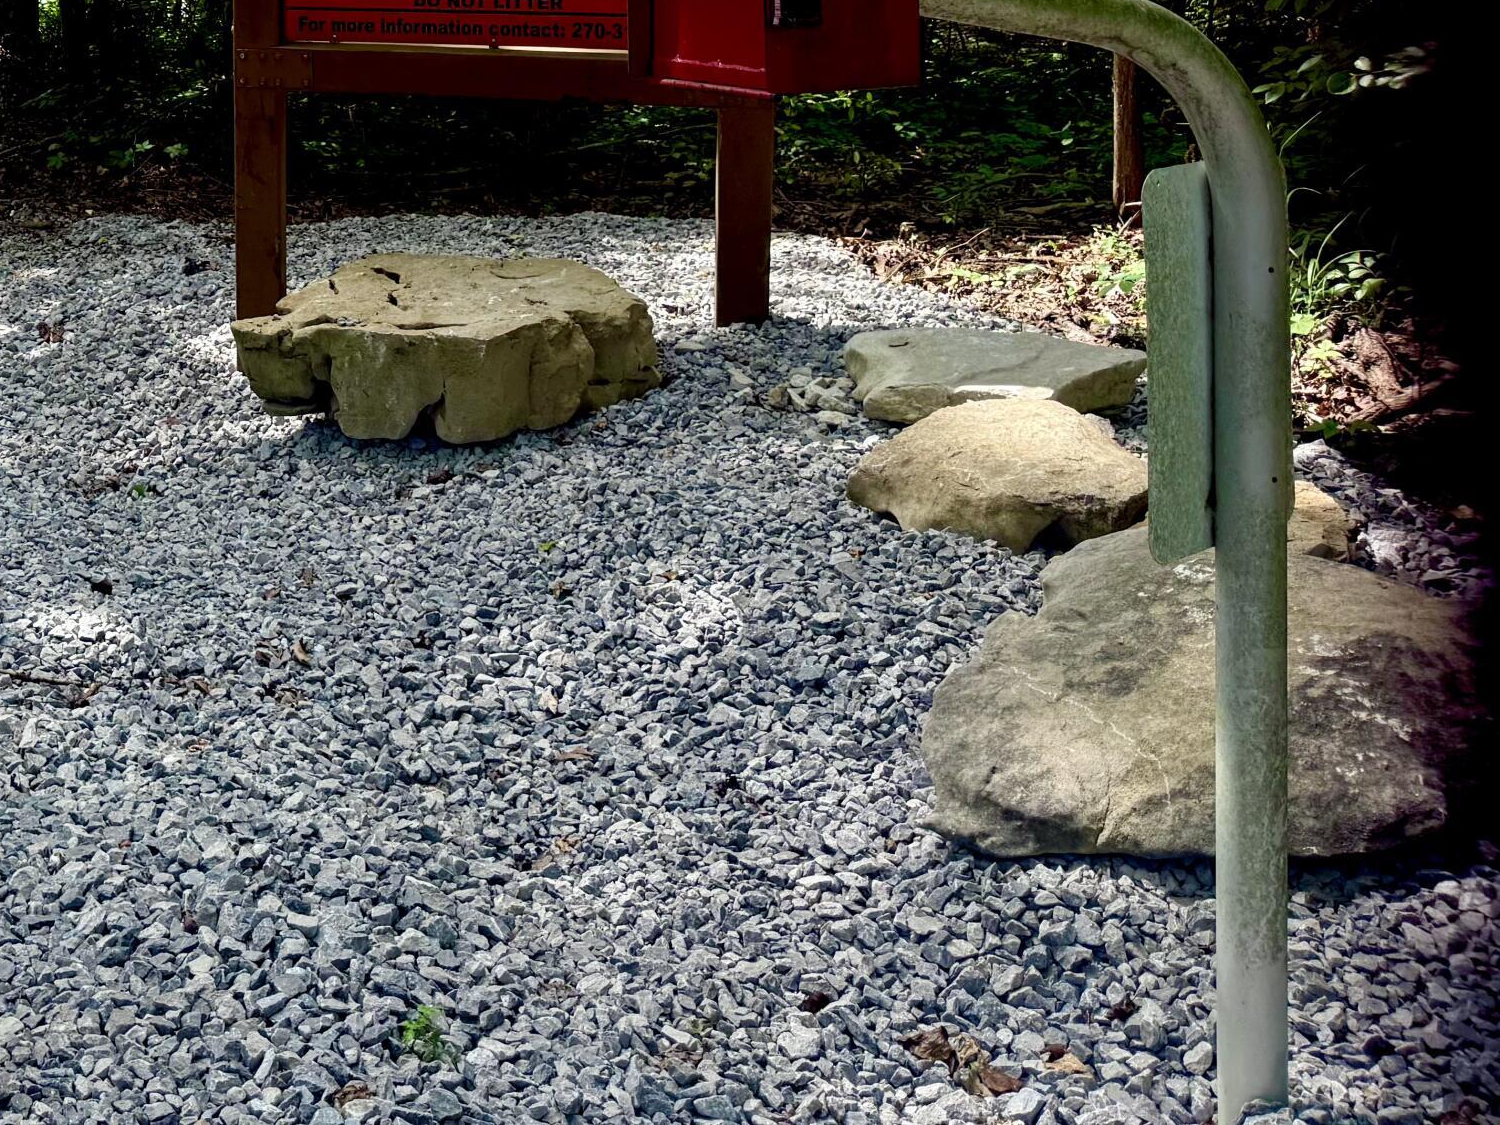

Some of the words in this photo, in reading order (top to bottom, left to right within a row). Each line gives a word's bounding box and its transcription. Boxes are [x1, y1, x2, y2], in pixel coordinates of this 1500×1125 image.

[299, 16, 324, 31] For
[332, 19, 374, 33] more
[491, 23, 565, 38] contact:
